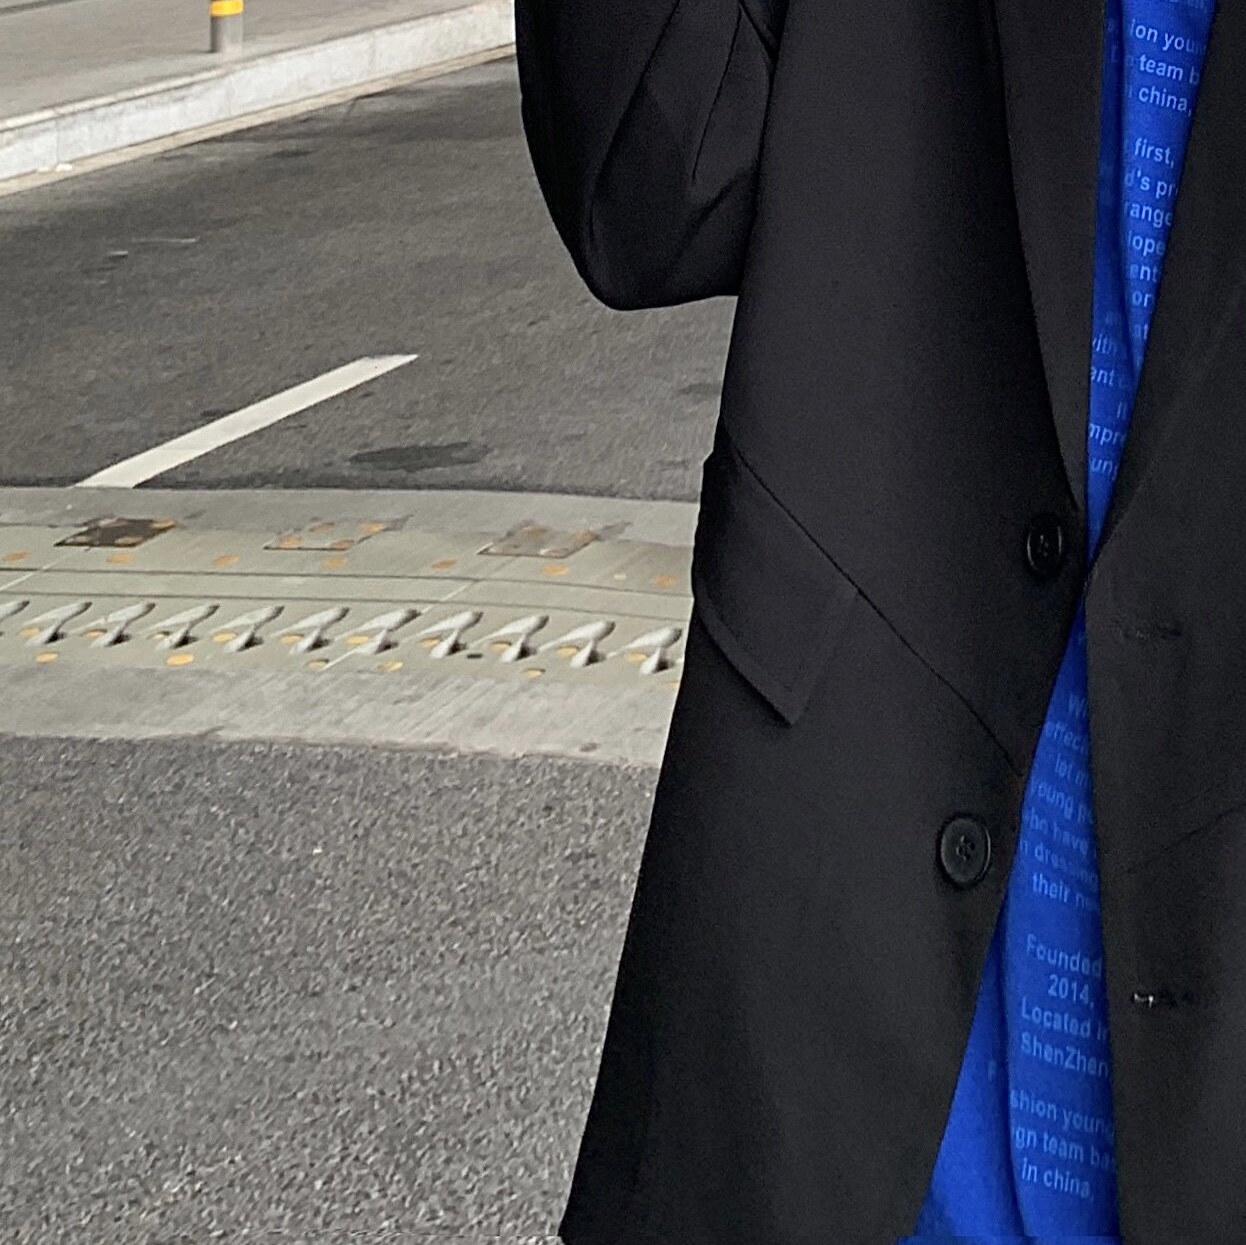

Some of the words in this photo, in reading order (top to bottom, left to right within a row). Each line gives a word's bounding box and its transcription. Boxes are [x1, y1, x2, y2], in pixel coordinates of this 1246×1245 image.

[1139, 54, 1184, 81] team
[1138, 85, 1192, 117] china,
[1134, 137, 1174, 169] first,
[1026, 933, 1102, 978] Founded
[1047, 973, 1095, 1010] 2014,
[1021, 995, 1091, 1039] Located
[1043, 1130, 1084, 1163] team
[1021, 1156, 1038, 1183] in
